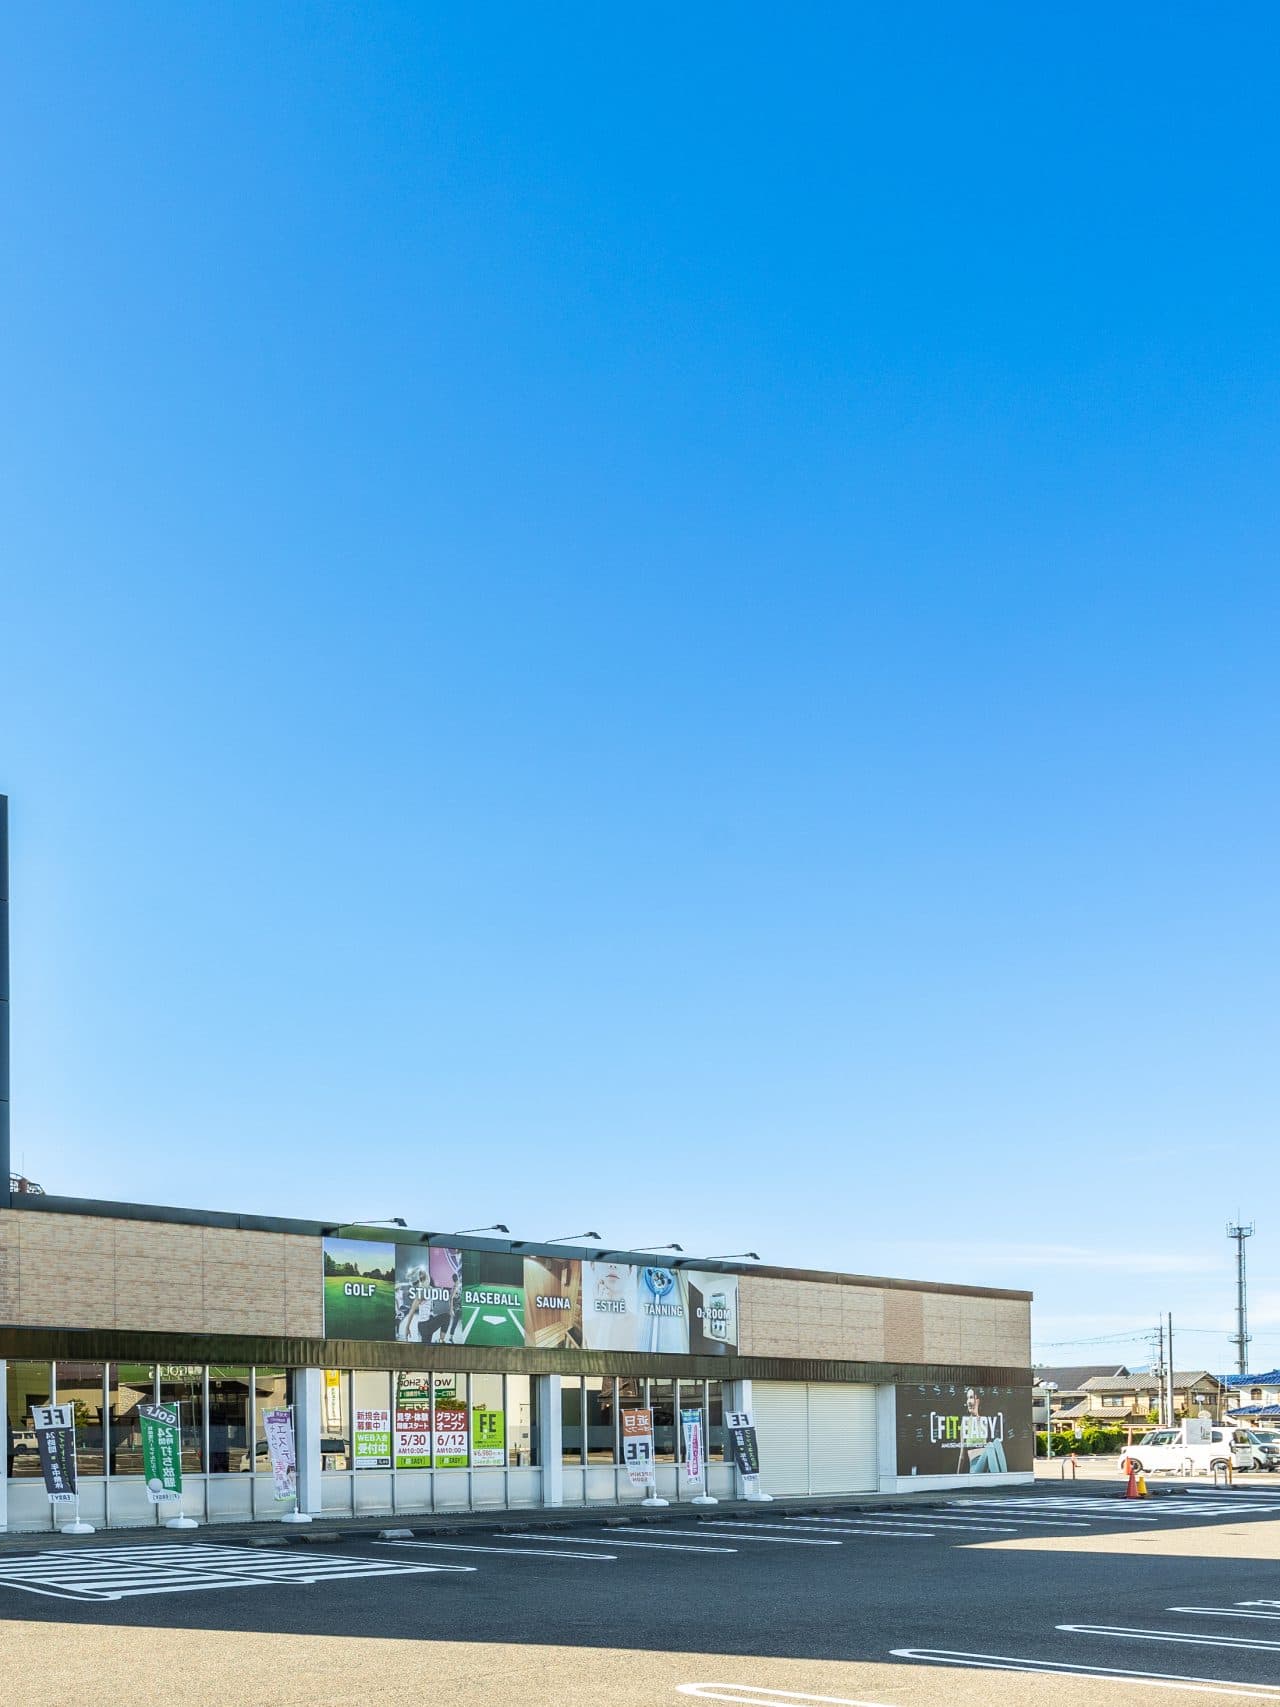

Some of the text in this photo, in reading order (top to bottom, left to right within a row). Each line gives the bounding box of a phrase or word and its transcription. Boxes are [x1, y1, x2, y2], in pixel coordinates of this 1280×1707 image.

[344, 1283, 376, 1297] GOLF
[408, 1287, 450, 1301] STUDIO
[465, 1292, 521, 1306] BASEBALL
[536, 1296, 571, 1309] SAUNA
[644, 1303, 684, 1317] TANNING
[356, 1411, 388, 1421] 新規会員
[436, 1412, 465, 1422] グランド
[436, 1422, 465, 1431] オープン
[400, 1434, 427, 1446] 5/30
[437, 1434, 465, 1446] 6/12
